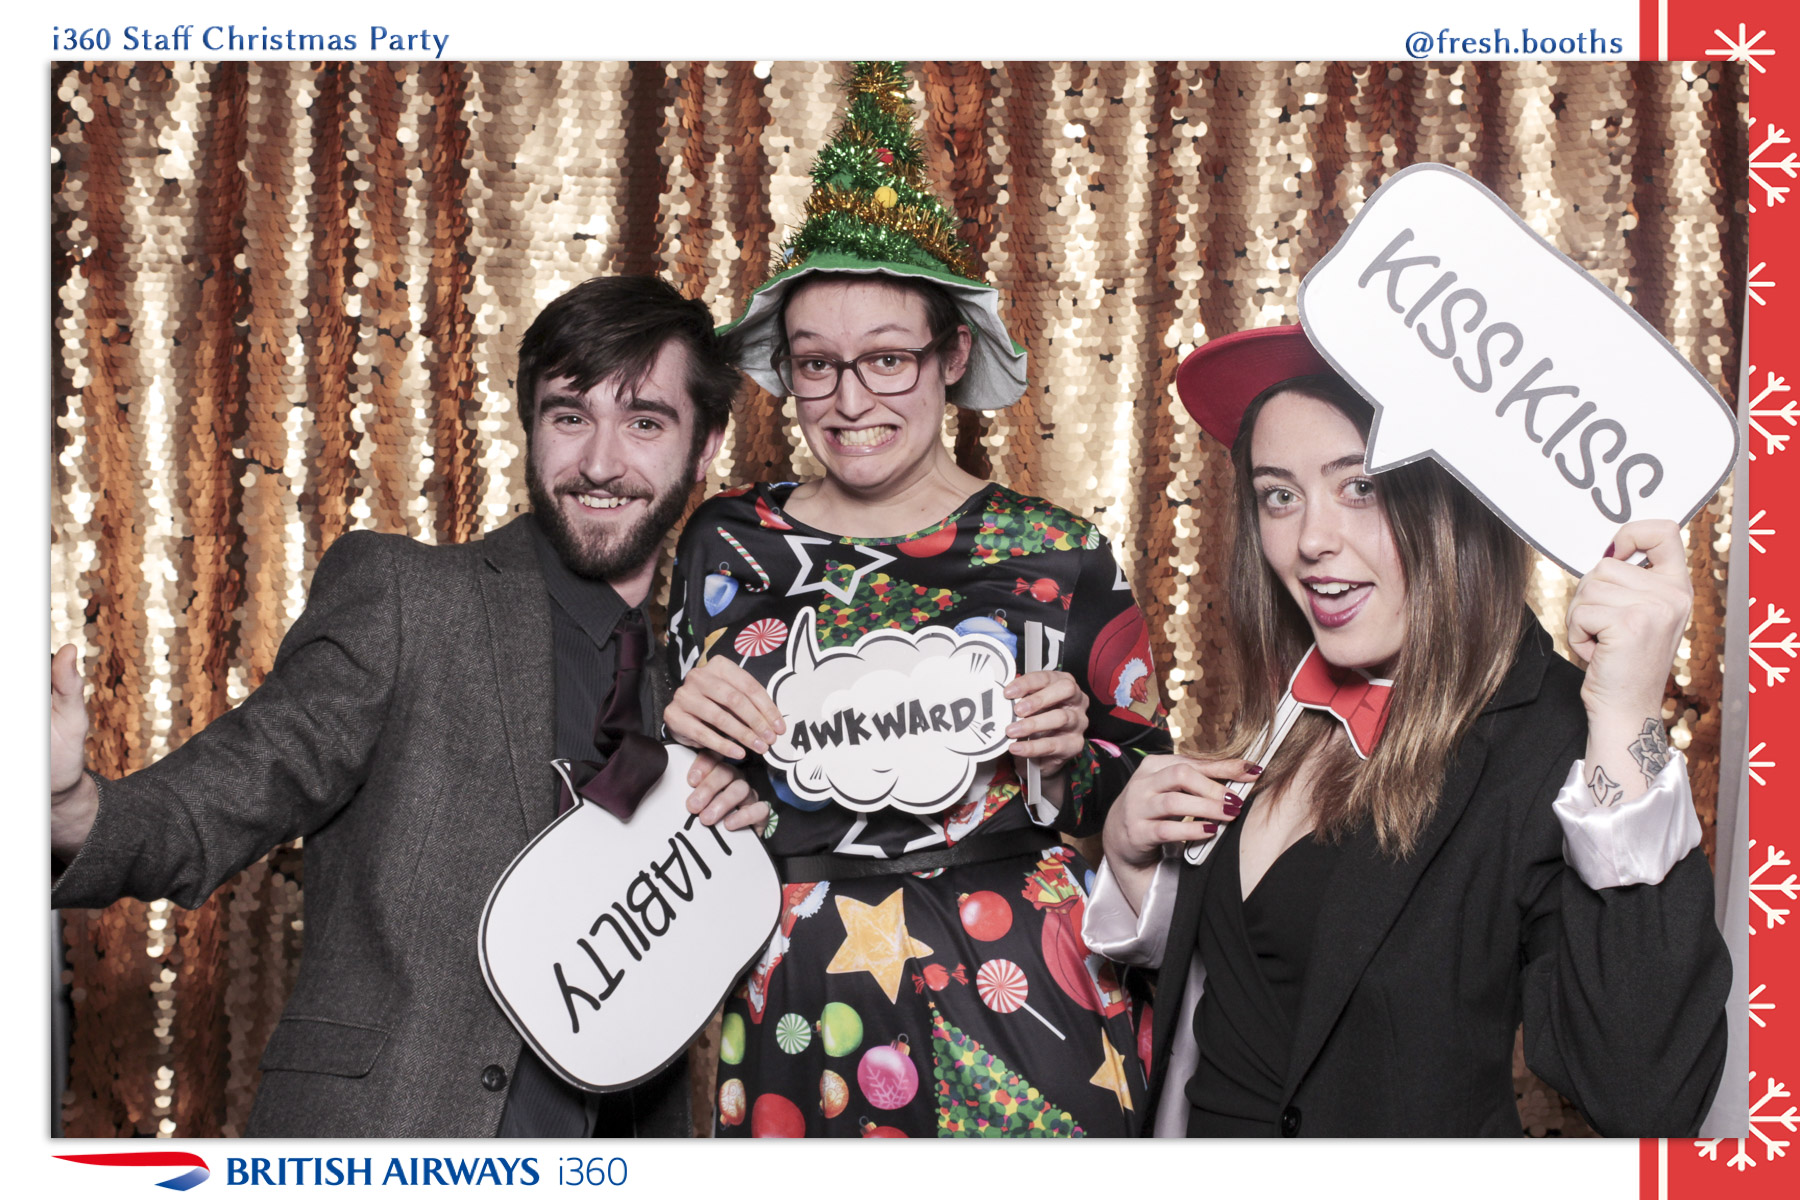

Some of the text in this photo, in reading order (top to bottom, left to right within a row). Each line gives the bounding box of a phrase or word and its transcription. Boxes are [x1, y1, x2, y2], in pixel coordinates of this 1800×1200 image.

[1358, 228, 1664, 524] KISS KISS
[790, 688, 995, 754] AWKWARD!
[553, 813, 732, 1034] LIABILTY
